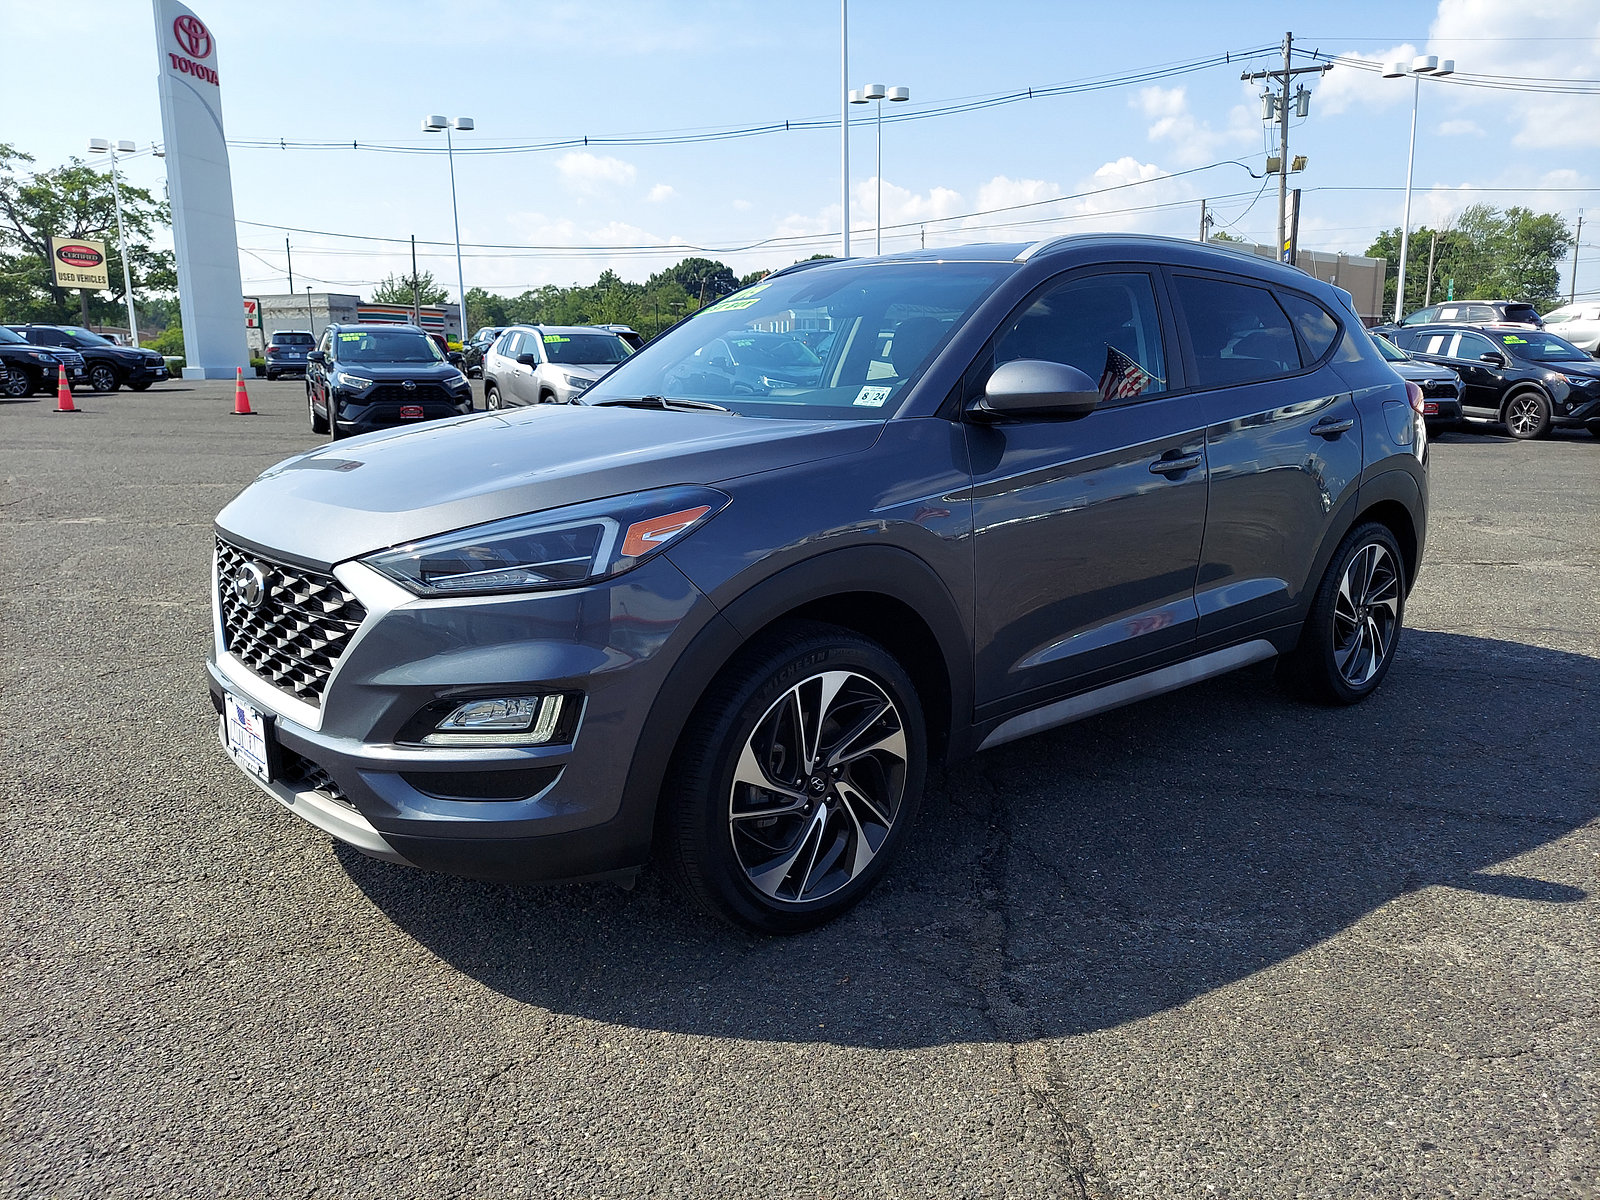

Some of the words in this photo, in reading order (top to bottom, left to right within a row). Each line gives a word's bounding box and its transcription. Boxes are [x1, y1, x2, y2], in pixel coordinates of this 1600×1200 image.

[168, 52, 219, 86] TOYOTA
[58, 272, 75, 281] USED
[76, 273, 106, 284] VEHICLES
[243, 301, 256, 327] 7
[861, 392, 870, 400] 8
[873, 392, 885, 401] 24
